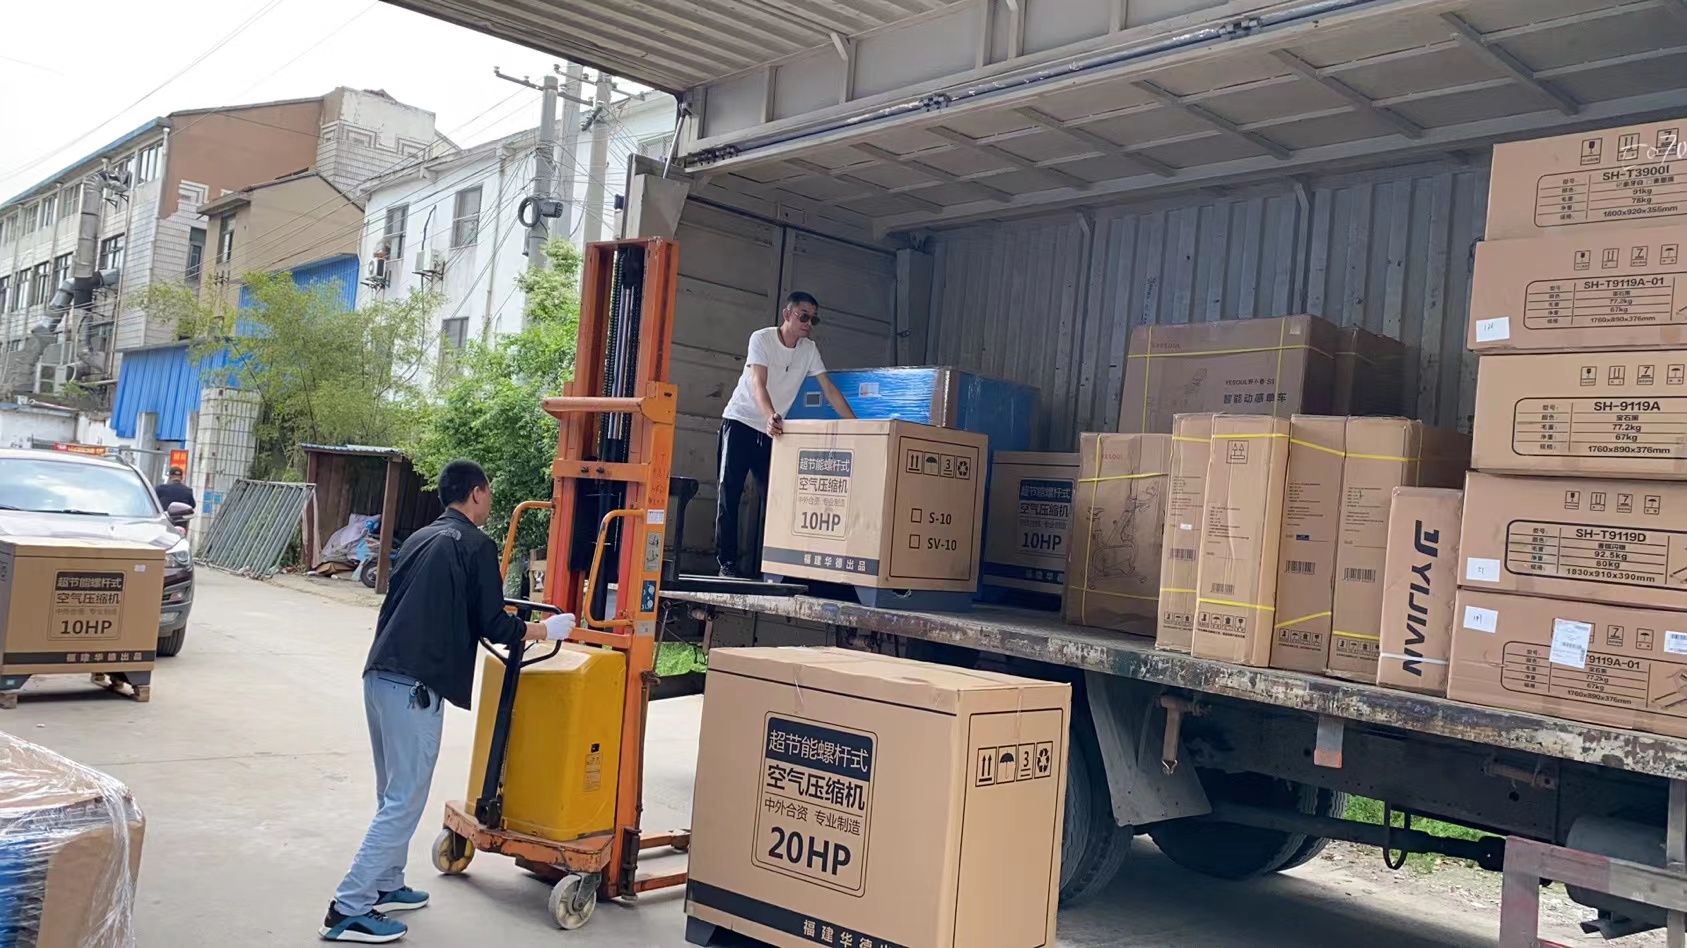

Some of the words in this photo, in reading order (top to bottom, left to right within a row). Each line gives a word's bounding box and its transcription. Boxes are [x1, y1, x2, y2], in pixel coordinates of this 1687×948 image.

[1584, 277, 1664, 289] SH-T9119A-01
[1594, 401, 1661, 411] SH-9119A
[1612, 423, 1642, 432] 77.2kg
[1615, 433, 1638, 443] 67kg
[1588, 445, 1671, 454] 1760x890x376mm
[800, 457, 850, 473] 超节能螺杆式
[799, 476, 848, 493] 空气压缩机
[1020, 502, 1069, 518] 空气压缩机
[801, 511, 841, 532] 10HP
[929, 512, 952, 525] S-10
[1021, 532, 1062, 551] 10HP
[1575, 528, 1647, 542] SH-T9119D
[927, 537, 957, 551] SV-10
[803, 553, 866, 572] 福建华德出品
[1594, 551, 1628, 561] 92.5kg
[1567, 568, 1655, 582] 1830x910x390mm
[56, 592, 120, 605] 空气压缩机
[1402, 562, 1432, 677] YIJIAN
[60, 620, 112, 635] 10HP
[1586, 654, 1640, 669] 9119A-01
[768, 729, 869, 773] 超节能螺杆式
[766, 764, 865, 811] 空气压缩机
[764, 797, 809, 822] 中外合资
[814, 809, 861, 836] 专业制造
[768, 826, 852, 876] 20HP
